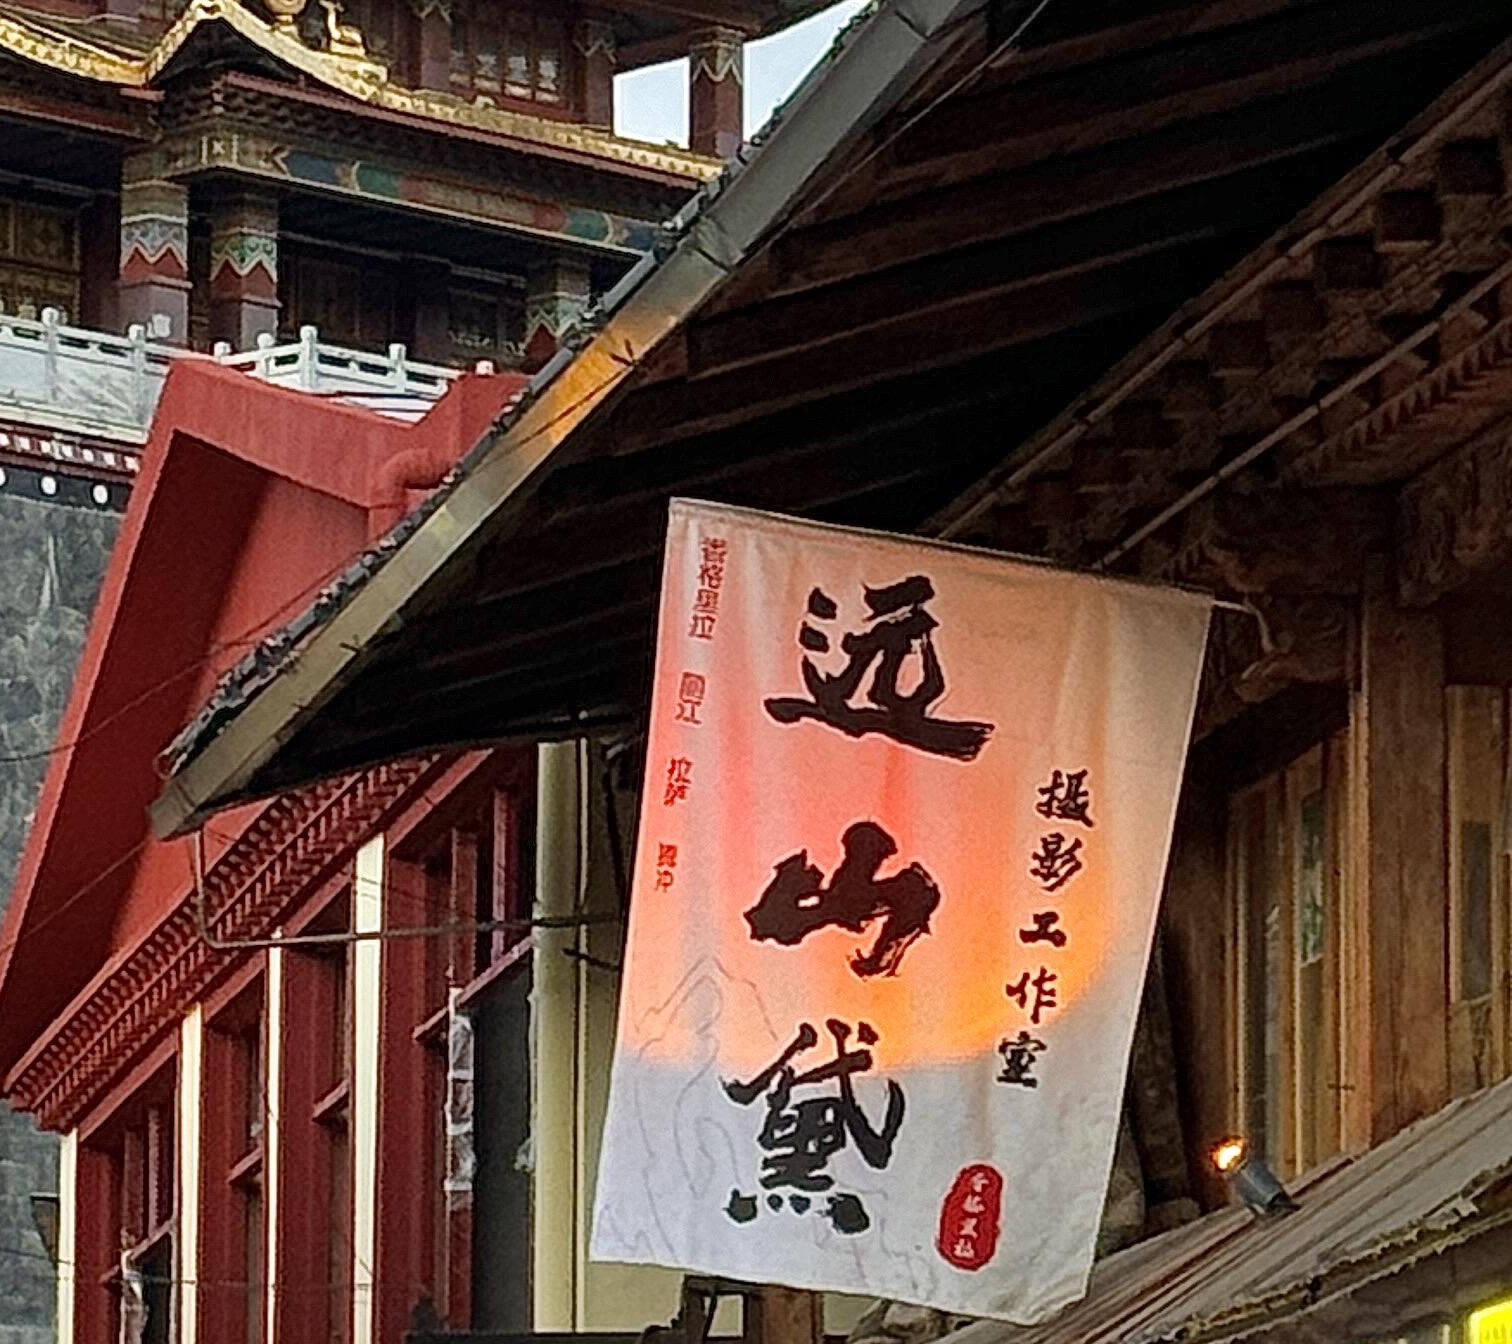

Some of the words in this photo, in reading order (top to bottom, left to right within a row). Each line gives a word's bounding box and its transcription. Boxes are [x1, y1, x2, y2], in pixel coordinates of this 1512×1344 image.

[687, 536, 729, 640] 香格里拉
[720, 574, 996, 1234] 远山黛
[995, 768, 1096, 1090] 摄影工作室
